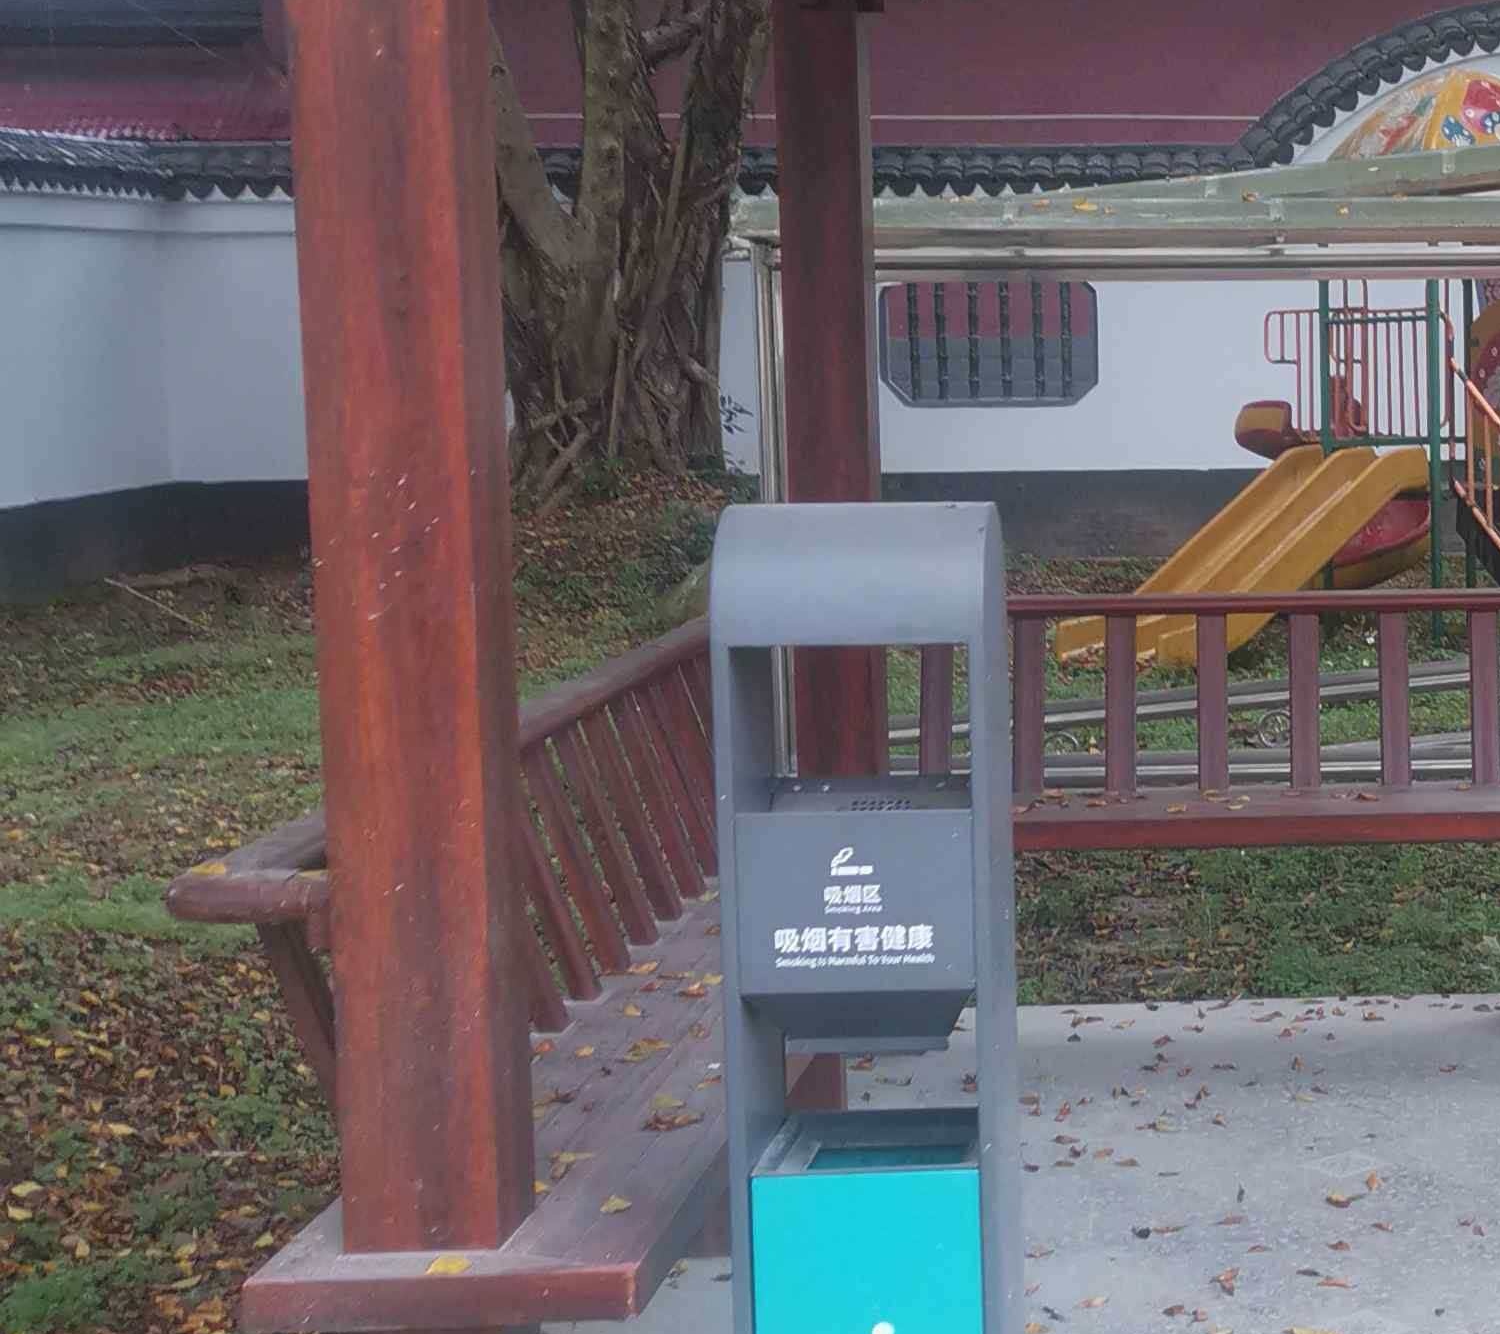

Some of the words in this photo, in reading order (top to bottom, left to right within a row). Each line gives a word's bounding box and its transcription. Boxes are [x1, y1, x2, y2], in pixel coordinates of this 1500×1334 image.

[823, 884, 882, 907] 吸烟区
[774, 923, 934, 953] 吸烟有害健康
